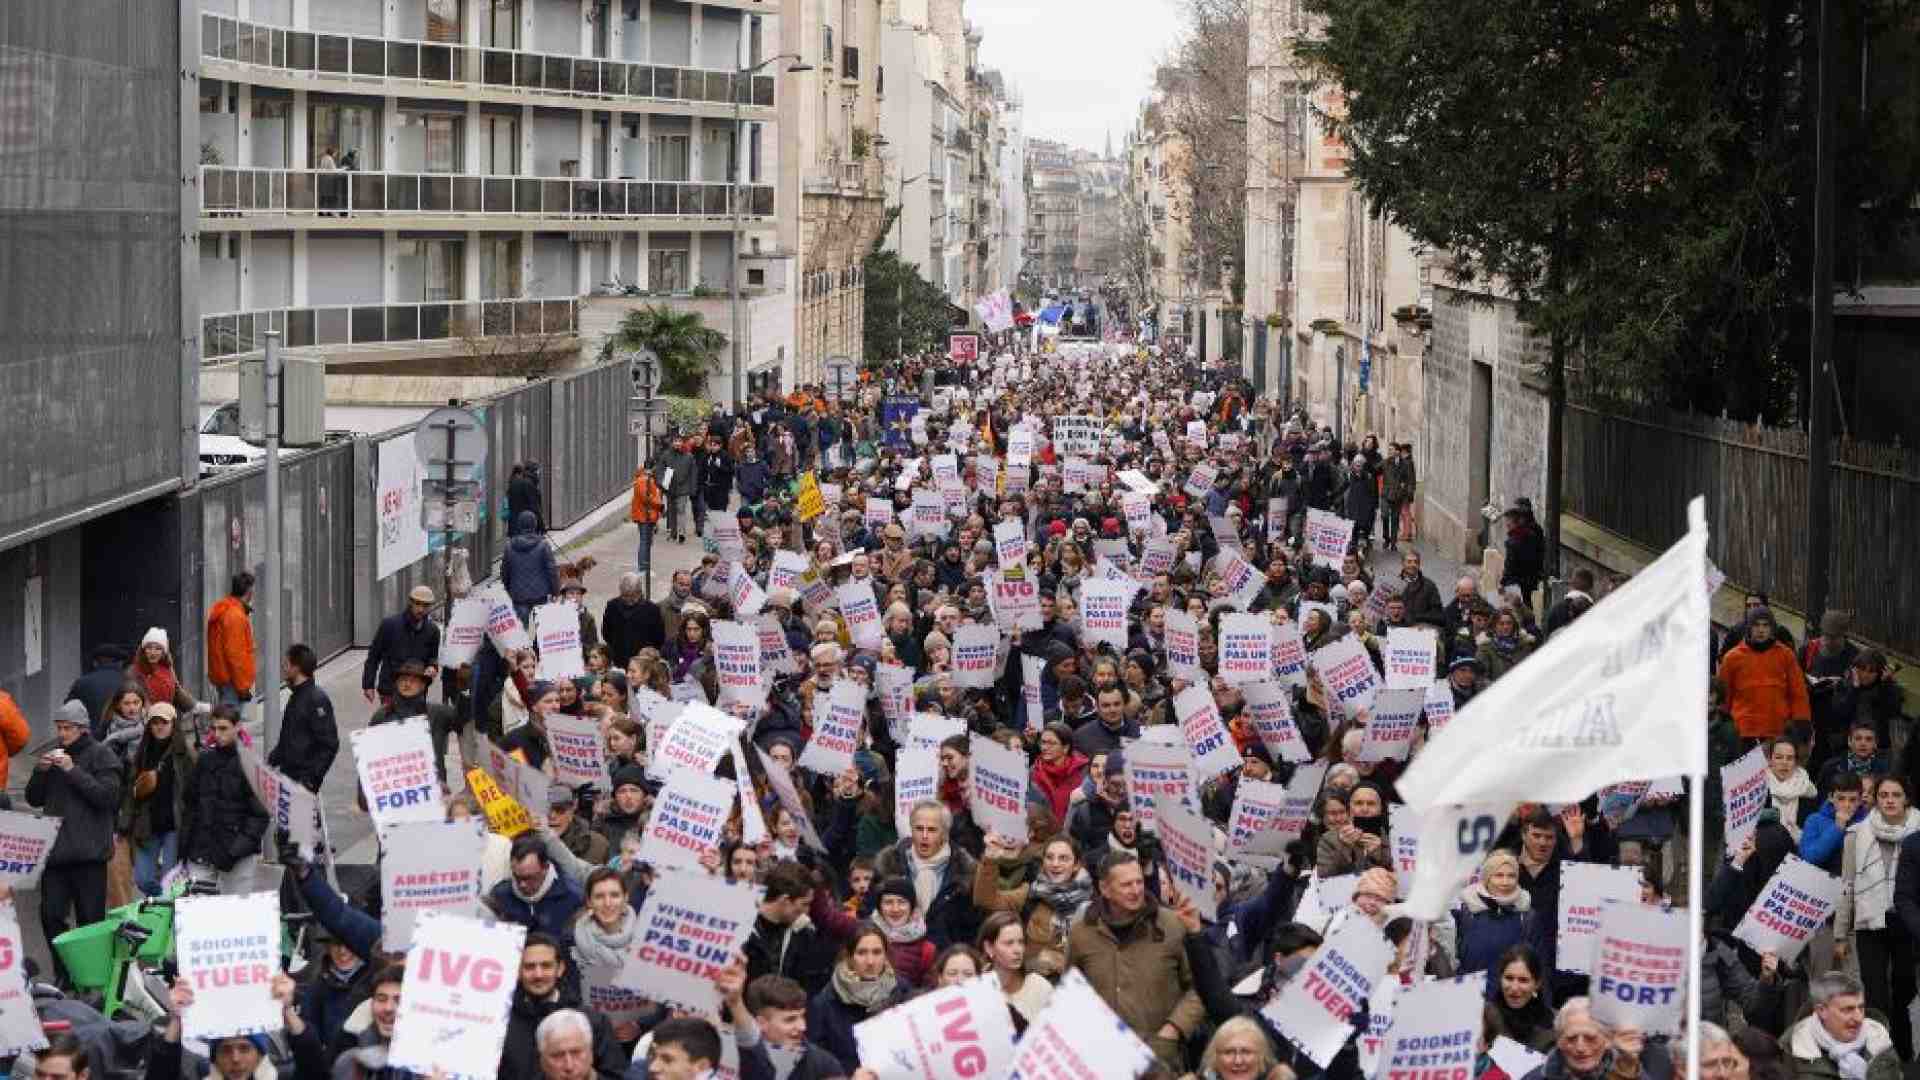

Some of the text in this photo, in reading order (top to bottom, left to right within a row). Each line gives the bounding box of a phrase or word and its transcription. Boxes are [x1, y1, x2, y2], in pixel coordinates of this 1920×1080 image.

[997, 582, 1033, 597] IVG
[1337, 675, 1375, 703] FORT
[1196, 732, 1224, 755] ORT
[376, 786, 432, 812] FORT
[976, 788, 1020, 815] TUER
[658, 812, 714, 839] PAS UN
[653, 827, 712, 855] CHOIX
[0, 859, 34, 872] ORT
[650, 915, 736, 946] UN DROIT
[657, 903, 738, 931] VIVRE EST
[1756, 910, 1808, 940] CHOIX
[192, 934, 268, 953] SOIGNER
[238, 947, 269, 963] PAS
[645, 929, 731, 965] PAS UN
[191, 965, 269, 990] TUER
[417, 947, 504, 993] IVG
[639, 946, 724, 982] CHOIX
[1302, 969, 1355, 1023] TUER
[1599, 976, 1676, 1005] FORT
[935, 996, 988, 1080] IVG
[1397, 1030, 1471, 1057] SOIGNER
[1444, 1048, 1471, 1066] PAS
